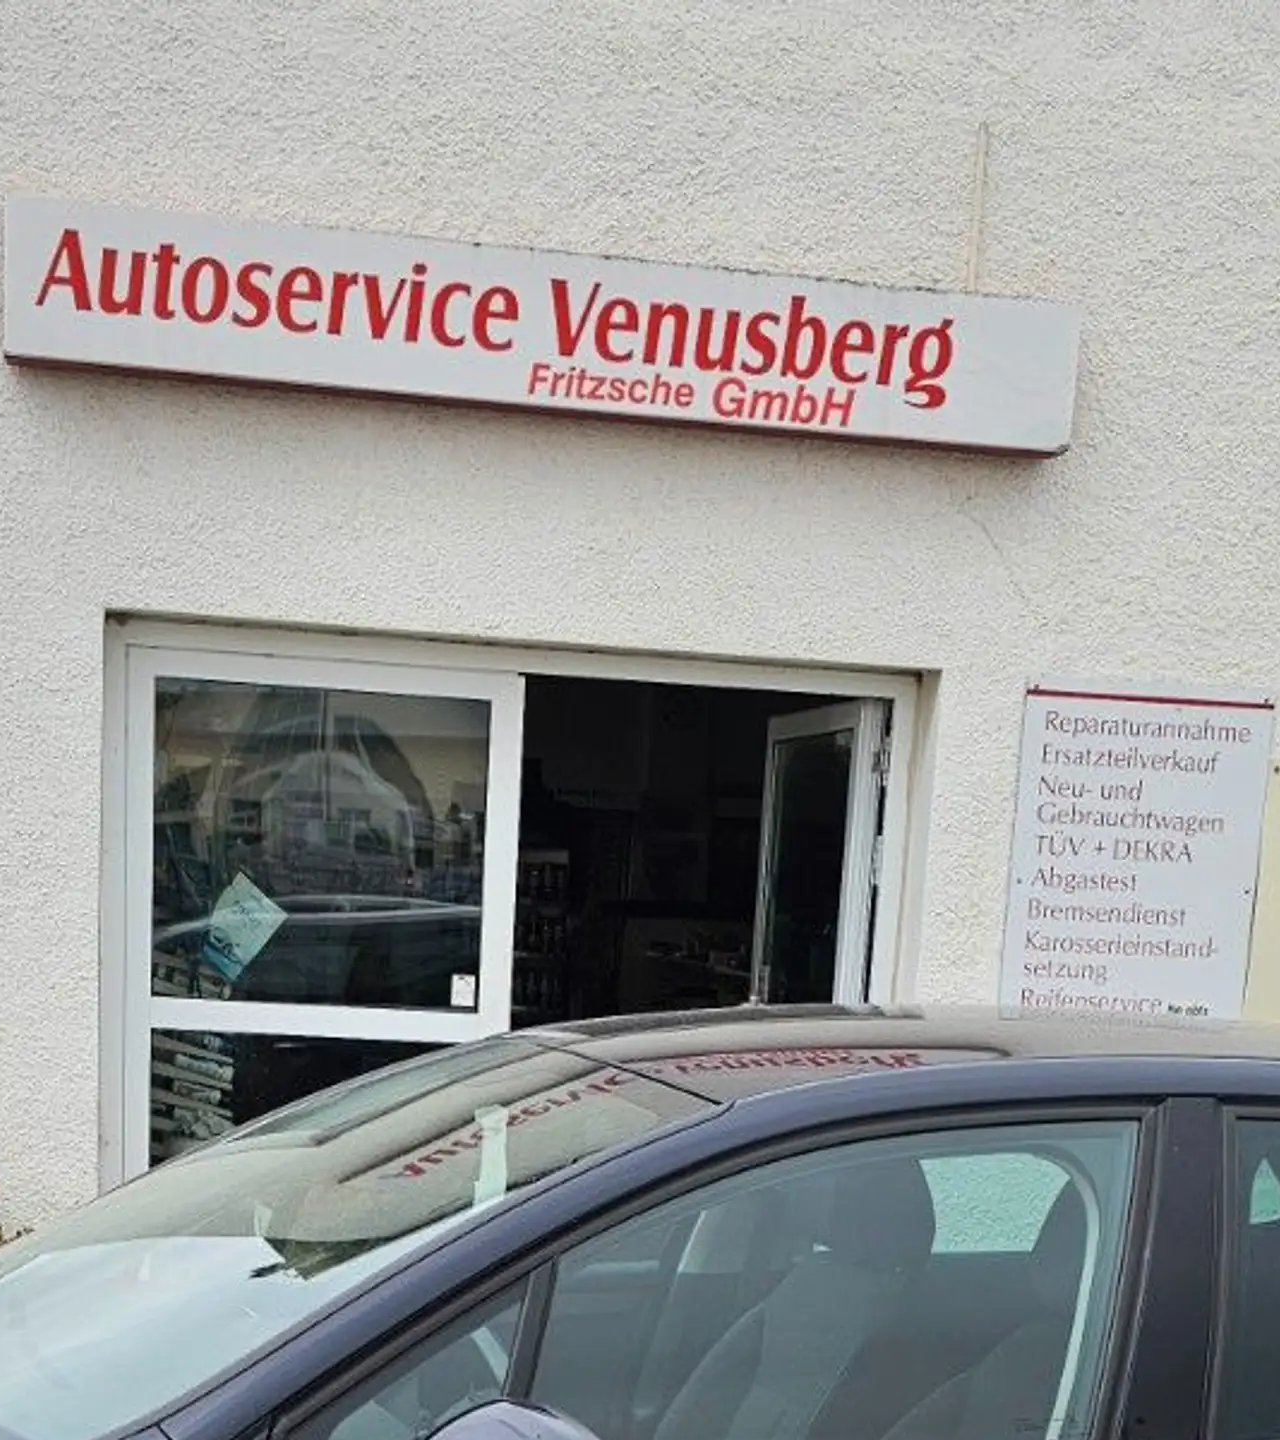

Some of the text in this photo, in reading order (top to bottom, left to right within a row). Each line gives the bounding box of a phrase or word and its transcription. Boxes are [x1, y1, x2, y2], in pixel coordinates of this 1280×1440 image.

[35, 227, 957, 409] Autoservice Venusberg
[526, 362, 858, 429] Fritzsche GmbH
[1044, 710, 1252, 743] Reparaturannahme
[1041, 743, 1220, 774] Ersatzteilverkauf
[1037, 776, 1143, 801] Neu- und
[1036, 802, 1225, 836] Gebrauchtwagen
[1034, 829, 1086, 857] TÜV
[1112, 840, 1193, 863] DEKRA
[1031, 866, 1137, 894] Abgastest
[1027, 898, 1186, 927] Bremsendienst
[1023, 960, 1107, 985] setzung
